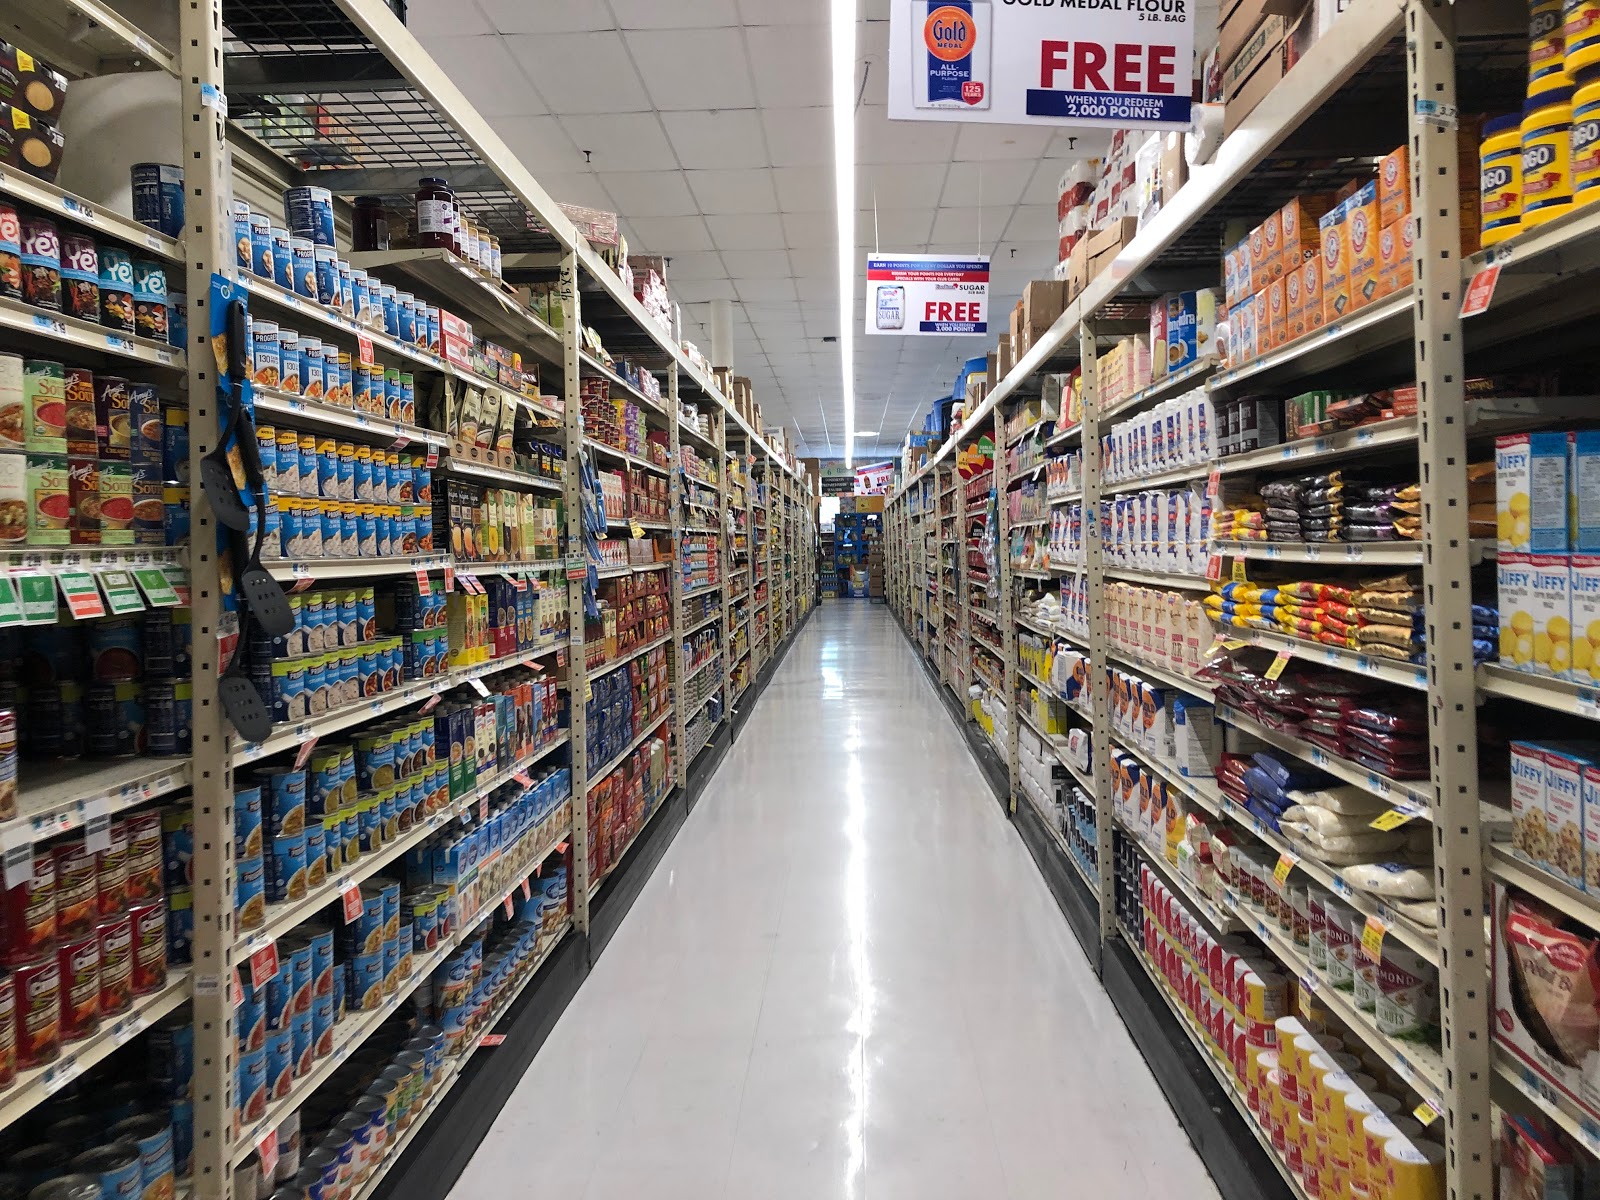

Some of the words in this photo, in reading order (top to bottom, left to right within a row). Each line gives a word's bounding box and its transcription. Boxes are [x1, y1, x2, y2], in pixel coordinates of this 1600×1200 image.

[1060, 0, 1122, 11] MEDAL
[1127, 0, 1186, 14] FLOUR
[1138, 13, 1146, 21] 5
[1147, 13, 1162, 22] LB.
[1164, 14, 1187, 23] BAG
[933, 19, 966, 42] Gold
[929, 69, 970, 78] PURPOSE
[1040, 39, 1177, 94] FREE
[964, 85, 981, 93] 125
[1064, 94, 1099, 105] WHEN
[1099, 96, 1123, 107] YOU
[1124, 97, 1164, 108] REDEEM
[1067, 104, 1107, 117] 2,000
[1109, 106, 1161, 119] POINTS
[878, 310, 900, 320] SUGAR
[924, 301, 981, 322] FREE
[259, 354, 271, 364] 130
[1497, 452, 1527, 470] JIFFY
[1499, 568, 1530, 587] JIFFY
[1532, 571, 1567, 591] JIFFY
[1511, 757, 1543, 784] JIFFY
[1545, 769, 1578, 797] JIFFY
